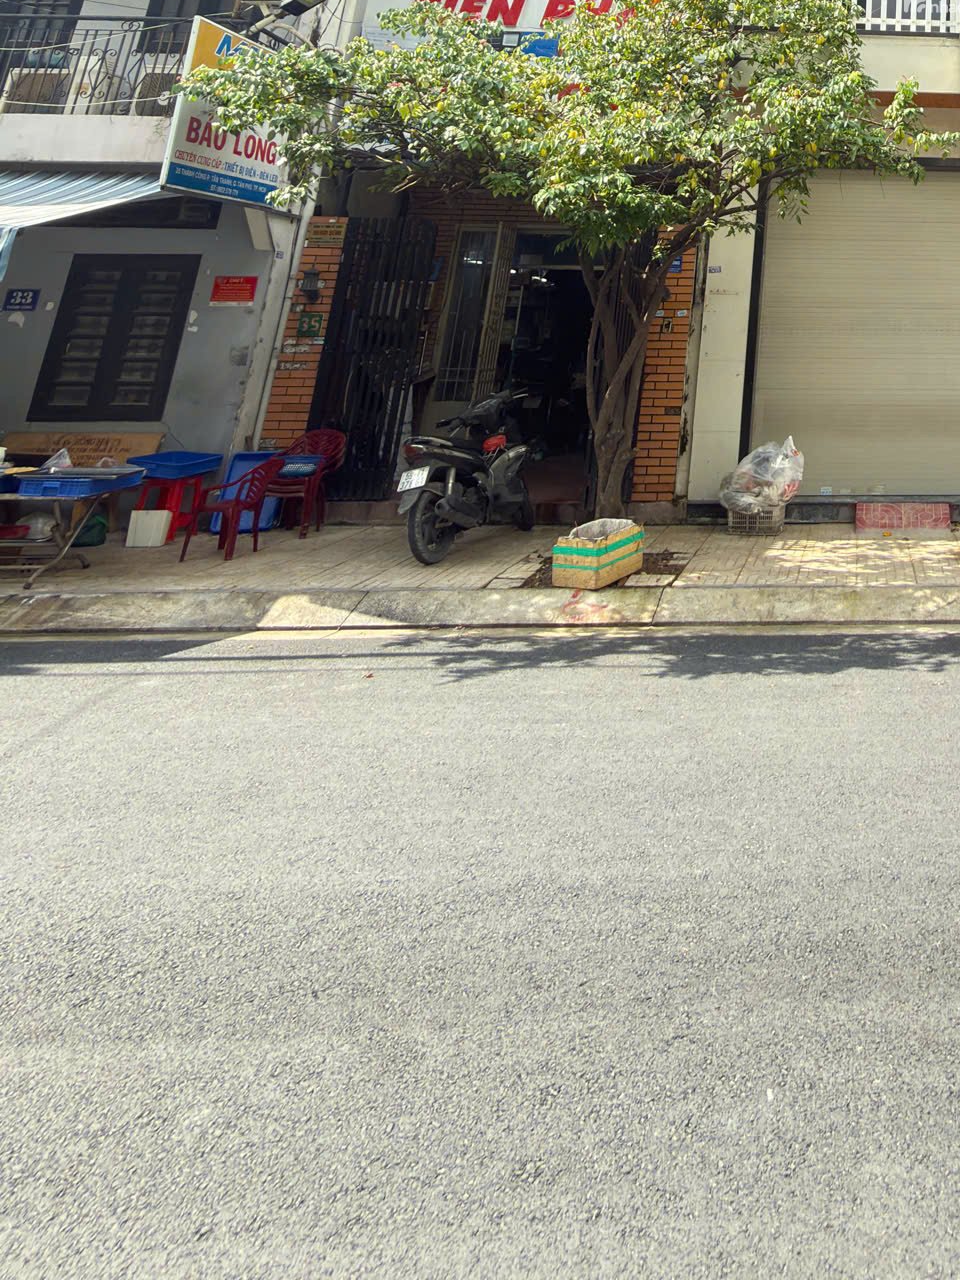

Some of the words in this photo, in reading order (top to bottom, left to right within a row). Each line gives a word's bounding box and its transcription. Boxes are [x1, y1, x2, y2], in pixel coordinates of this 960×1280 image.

[233, 131, 277, 165] LONG
[10, 291, 33, 304] 33
[301, 316, 321, 332] 35
